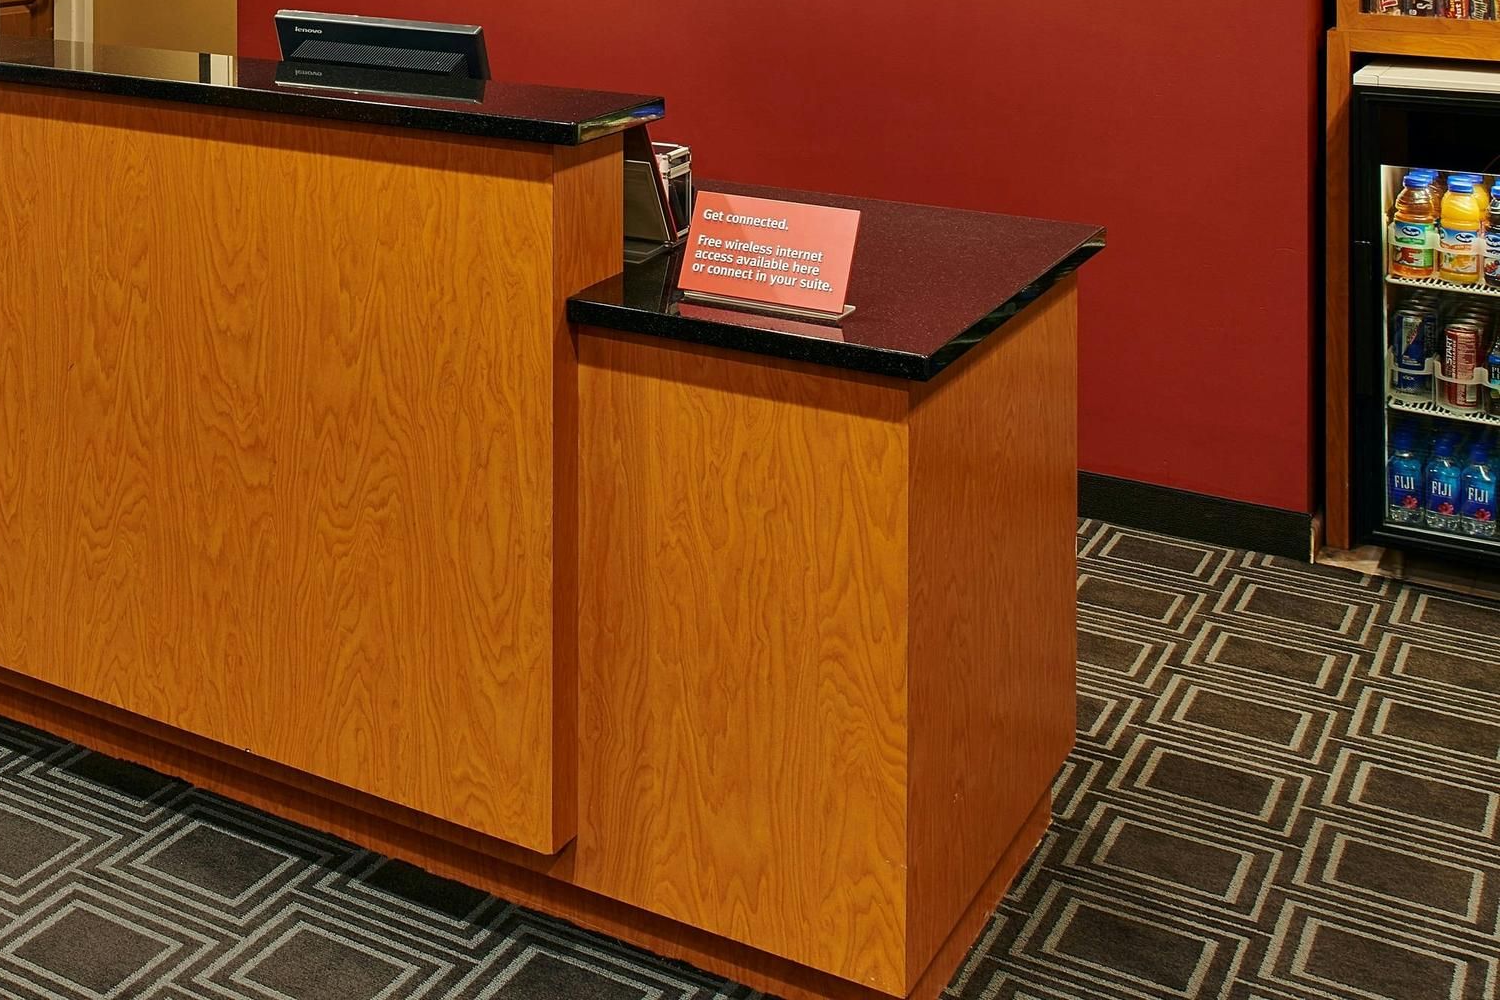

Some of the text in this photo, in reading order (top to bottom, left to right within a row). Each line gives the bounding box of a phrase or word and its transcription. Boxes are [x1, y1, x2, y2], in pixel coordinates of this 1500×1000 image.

[295, 26, 323, 34] lenovo
[703, 208, 789, 230] Get connected.
[697, 234, 823, 262] Free wireless internet
[694, 250, 820, 276] access available here
[692, 262, 833, 292] or connect in your suite.
[1394, 475, 1414, 490] FIJI
[1431, 481, 1452, 497] FIJI
[1468, 487, 1489, 503] FIJI
